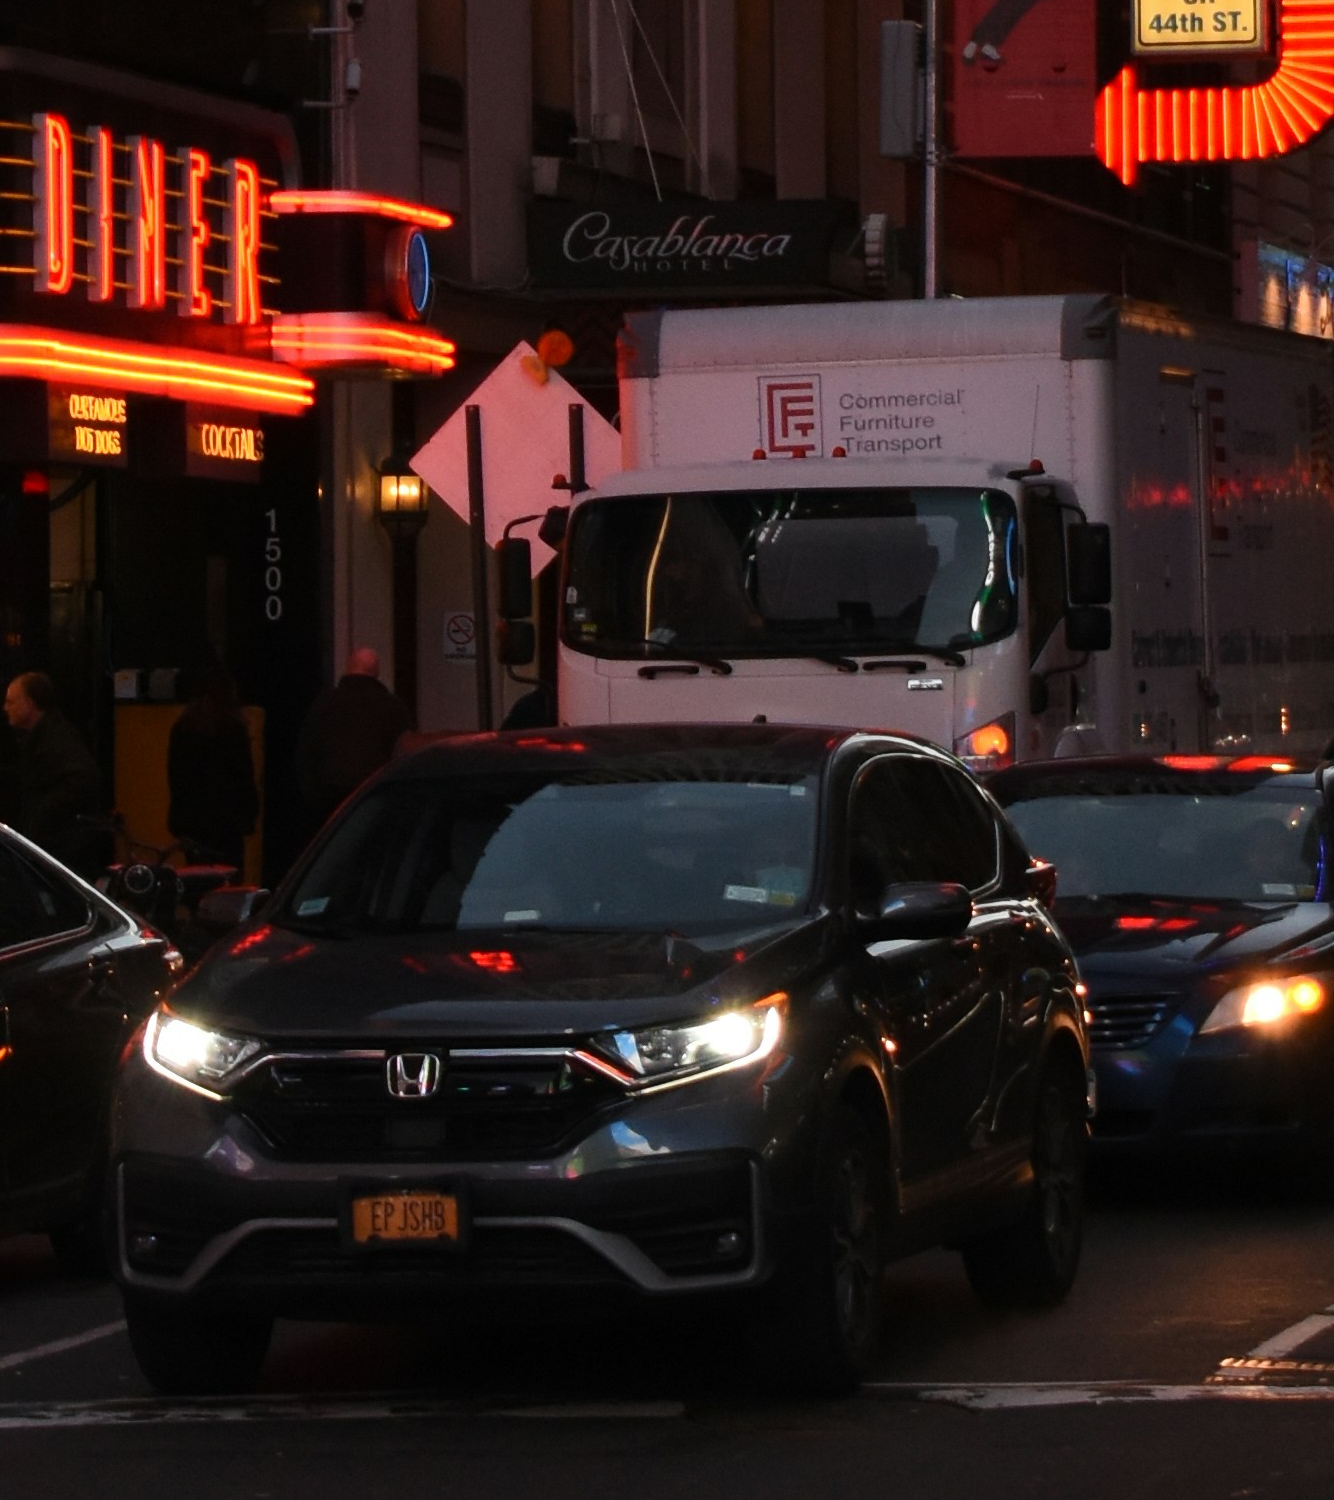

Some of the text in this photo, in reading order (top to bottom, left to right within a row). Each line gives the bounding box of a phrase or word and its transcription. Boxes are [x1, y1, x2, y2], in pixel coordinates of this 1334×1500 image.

[1148, 11, 1248, 34] 44th ST.
[32, 110, 264, 326] DINER
[562, 211, 793, 271] Casablanca
[633, 258, 735, 273] HOTEL
[839, 389, 962, 410] Commercial
[839, 413, 936, 432] Furniture
[201, 423, 265, 461] COCKTAILS
[841, 434, 943, 454] Transport
[265, 508, 283, 620] 1500
